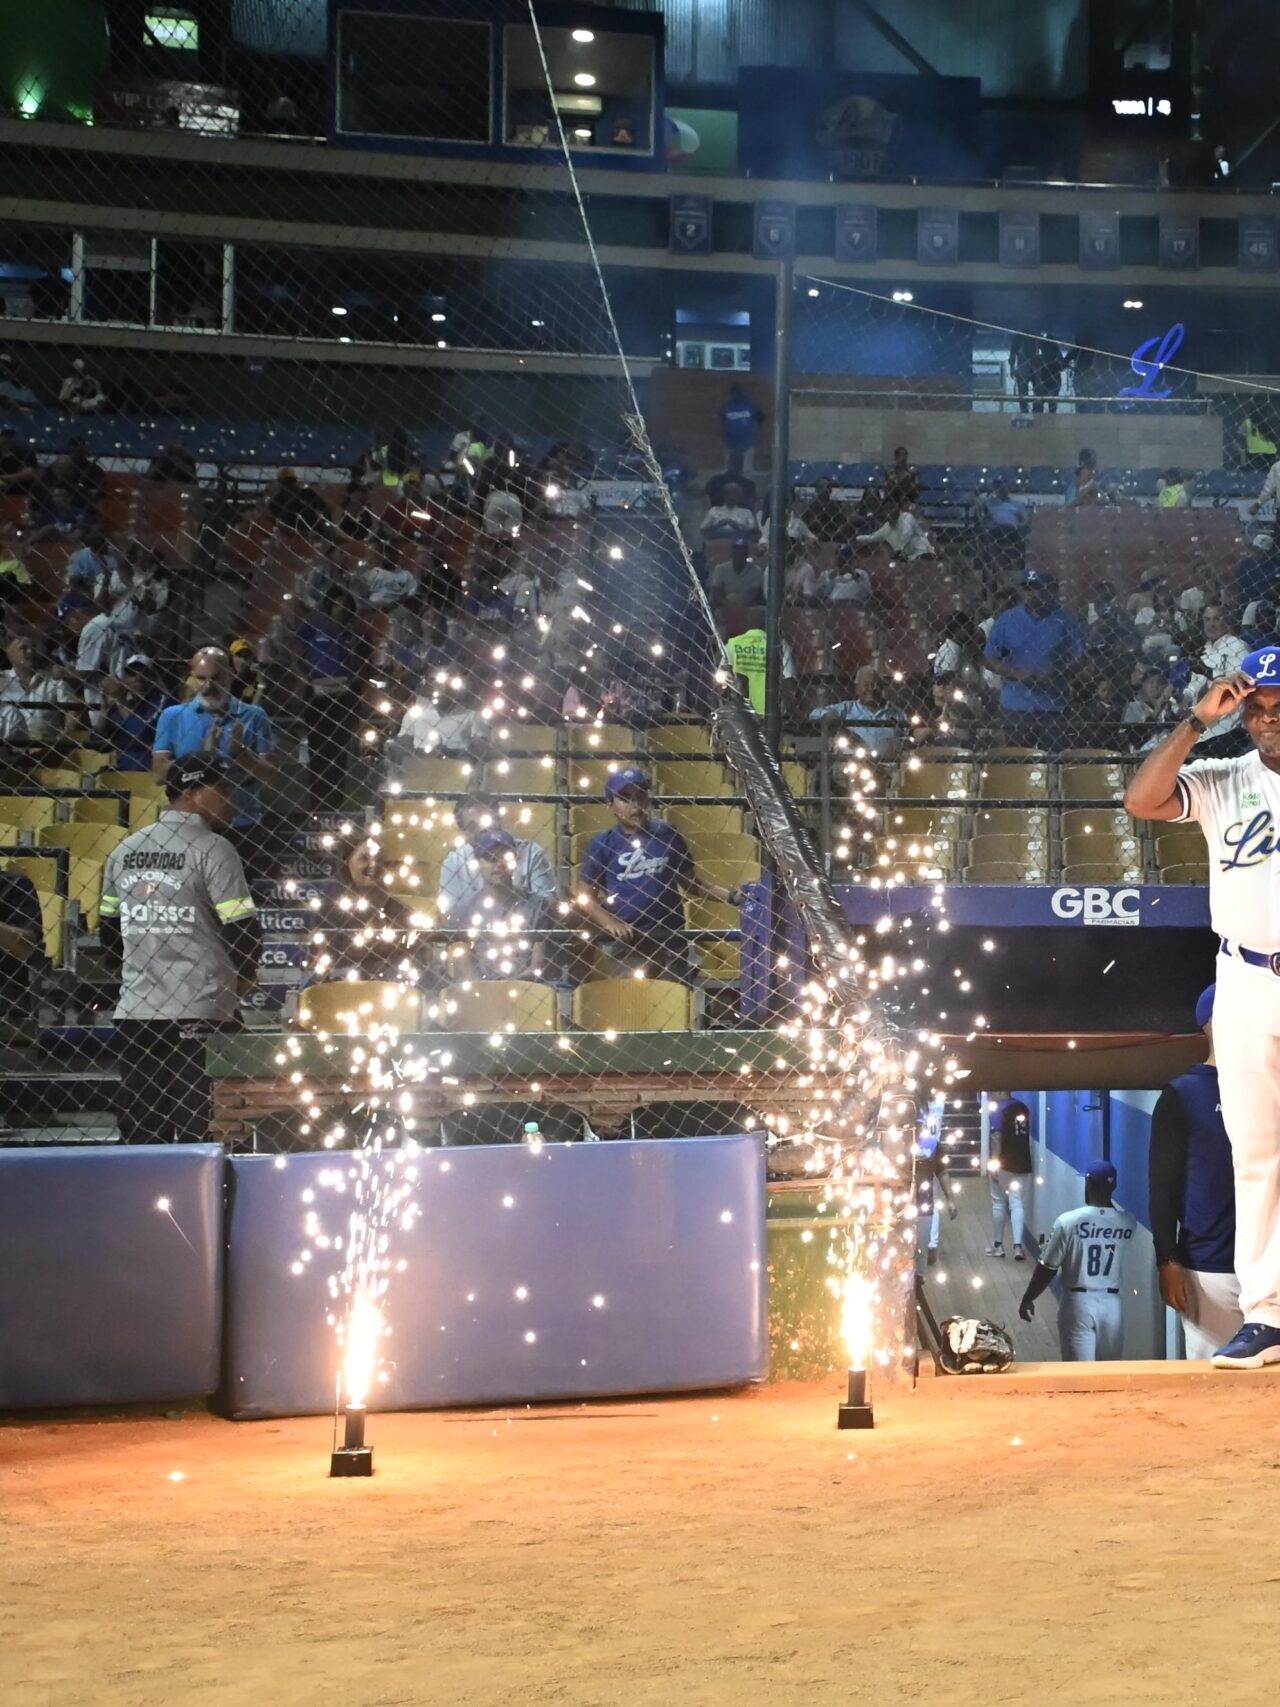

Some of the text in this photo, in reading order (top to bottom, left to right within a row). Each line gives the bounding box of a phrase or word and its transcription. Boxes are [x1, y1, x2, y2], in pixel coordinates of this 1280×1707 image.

[1256, 653, 1276, 678] L
[122, 851, 186, 871] SEGURIDAD
[1051, 888, 1140, 918] GBC
[257, 914, 305, 930] ltice
[1080, 1222, 1134, 1240] Sirena
[1087, 1244, 1116, 1277] 87
